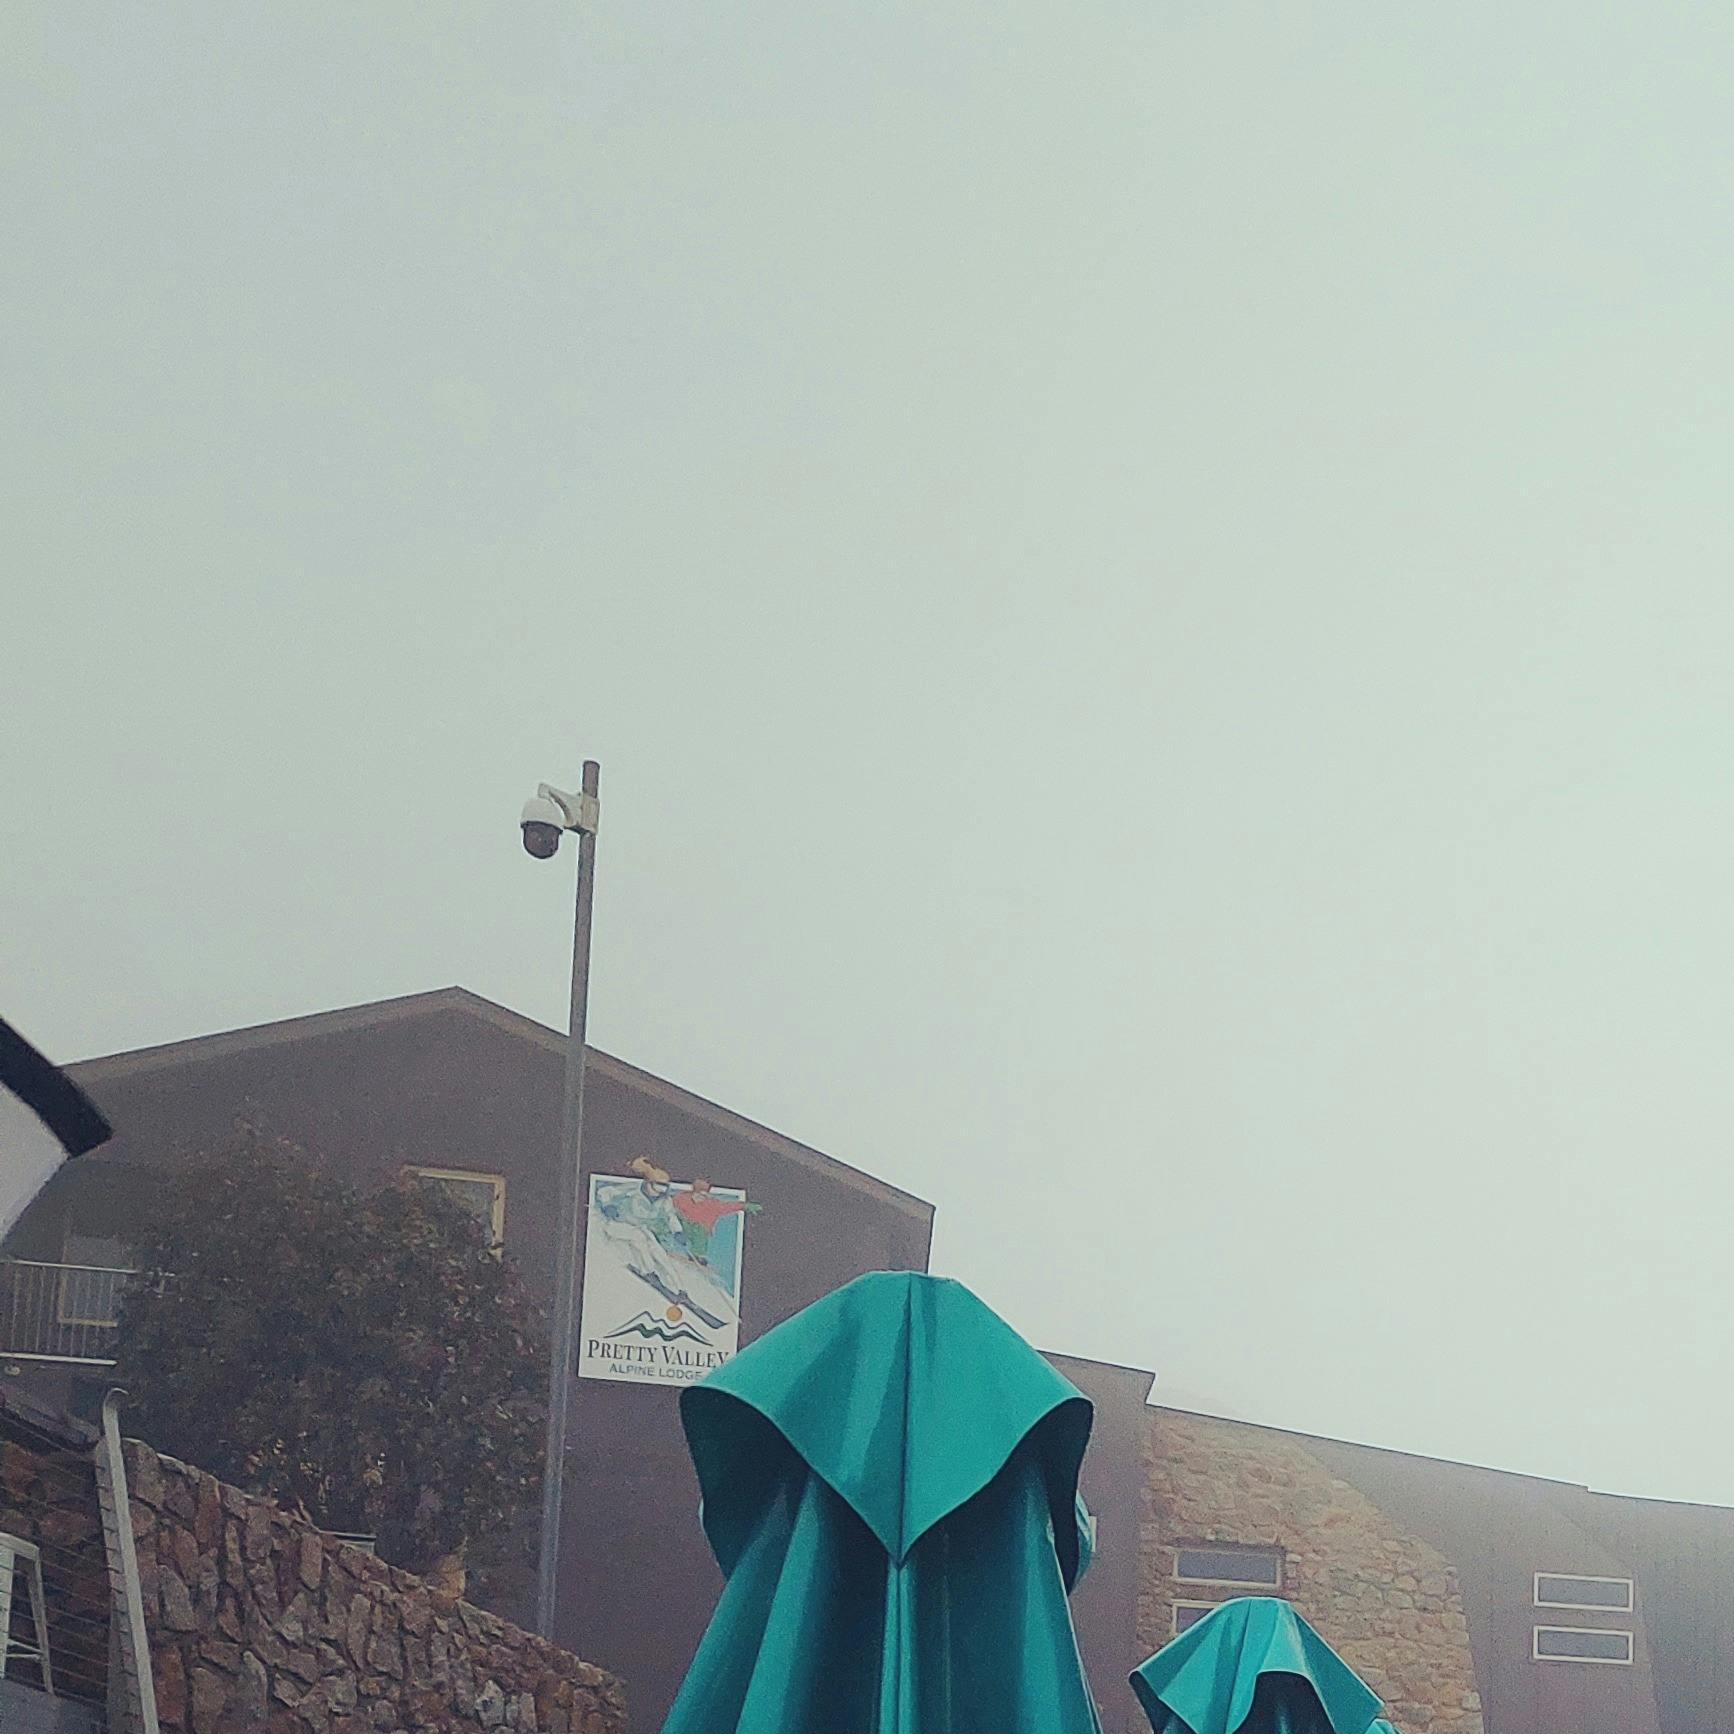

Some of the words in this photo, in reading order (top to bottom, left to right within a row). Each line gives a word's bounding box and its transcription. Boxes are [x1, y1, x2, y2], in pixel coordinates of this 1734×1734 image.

[587, 1339, 657, 1363] PRETTY
[609, 1362, 654, 1377] ALPINE
[659, 1366, 703, 1380] LODGE
